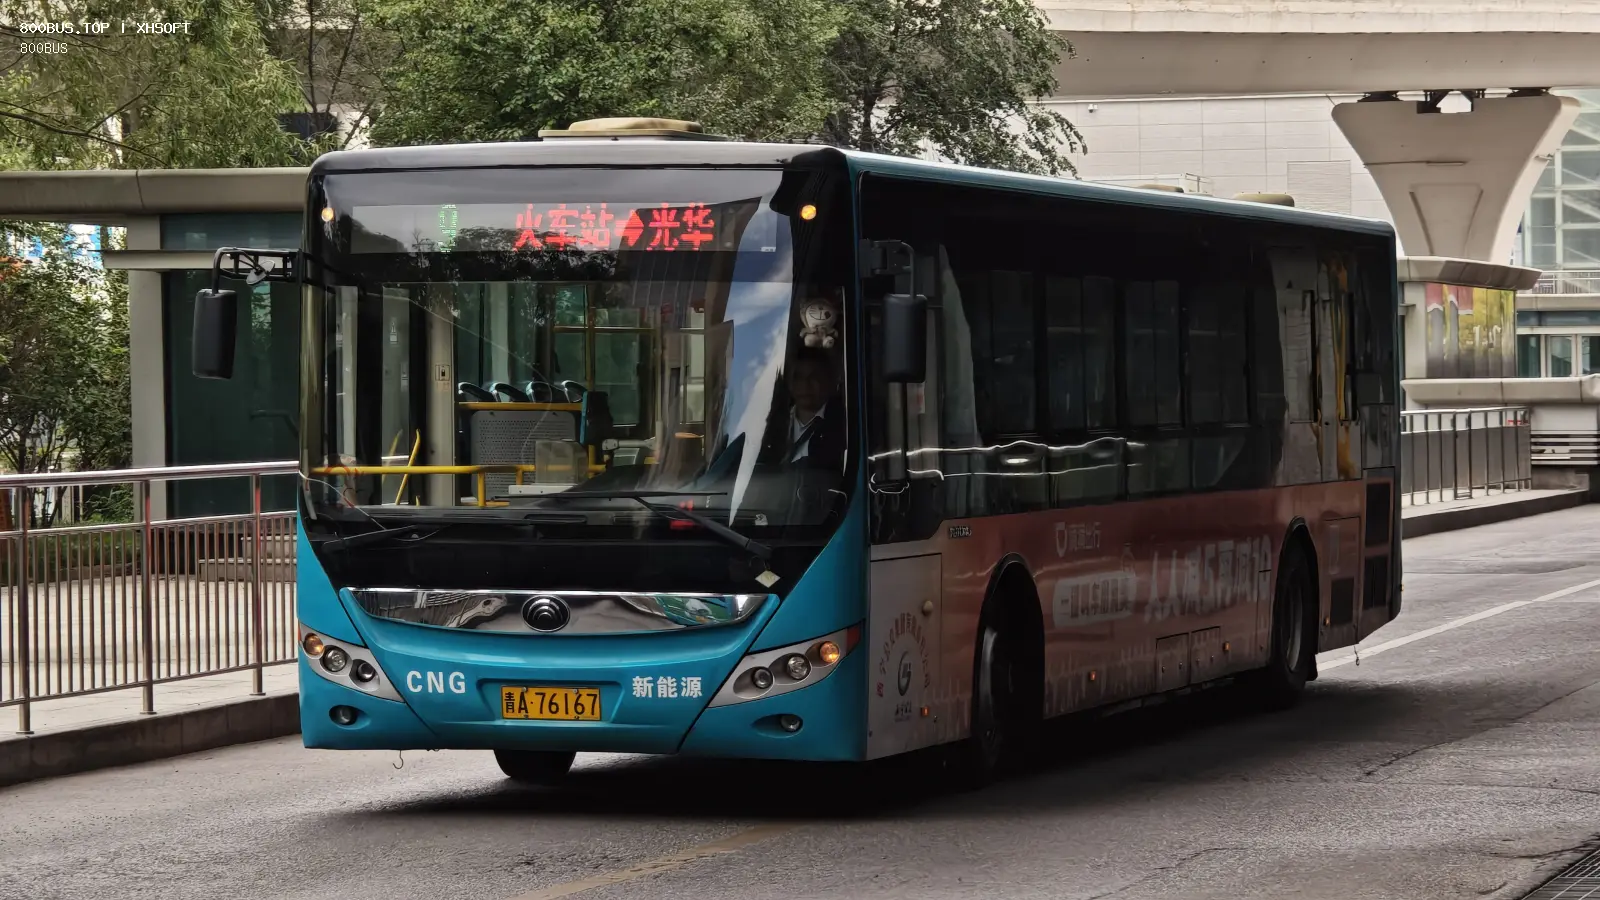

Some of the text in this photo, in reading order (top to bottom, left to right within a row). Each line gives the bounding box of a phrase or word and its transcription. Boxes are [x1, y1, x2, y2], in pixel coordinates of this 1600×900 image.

[511, 202, 715, 251] 火车站 光华
[406, 671, 466, 694] CNG
[632, 676, 702, 698] 新能源
